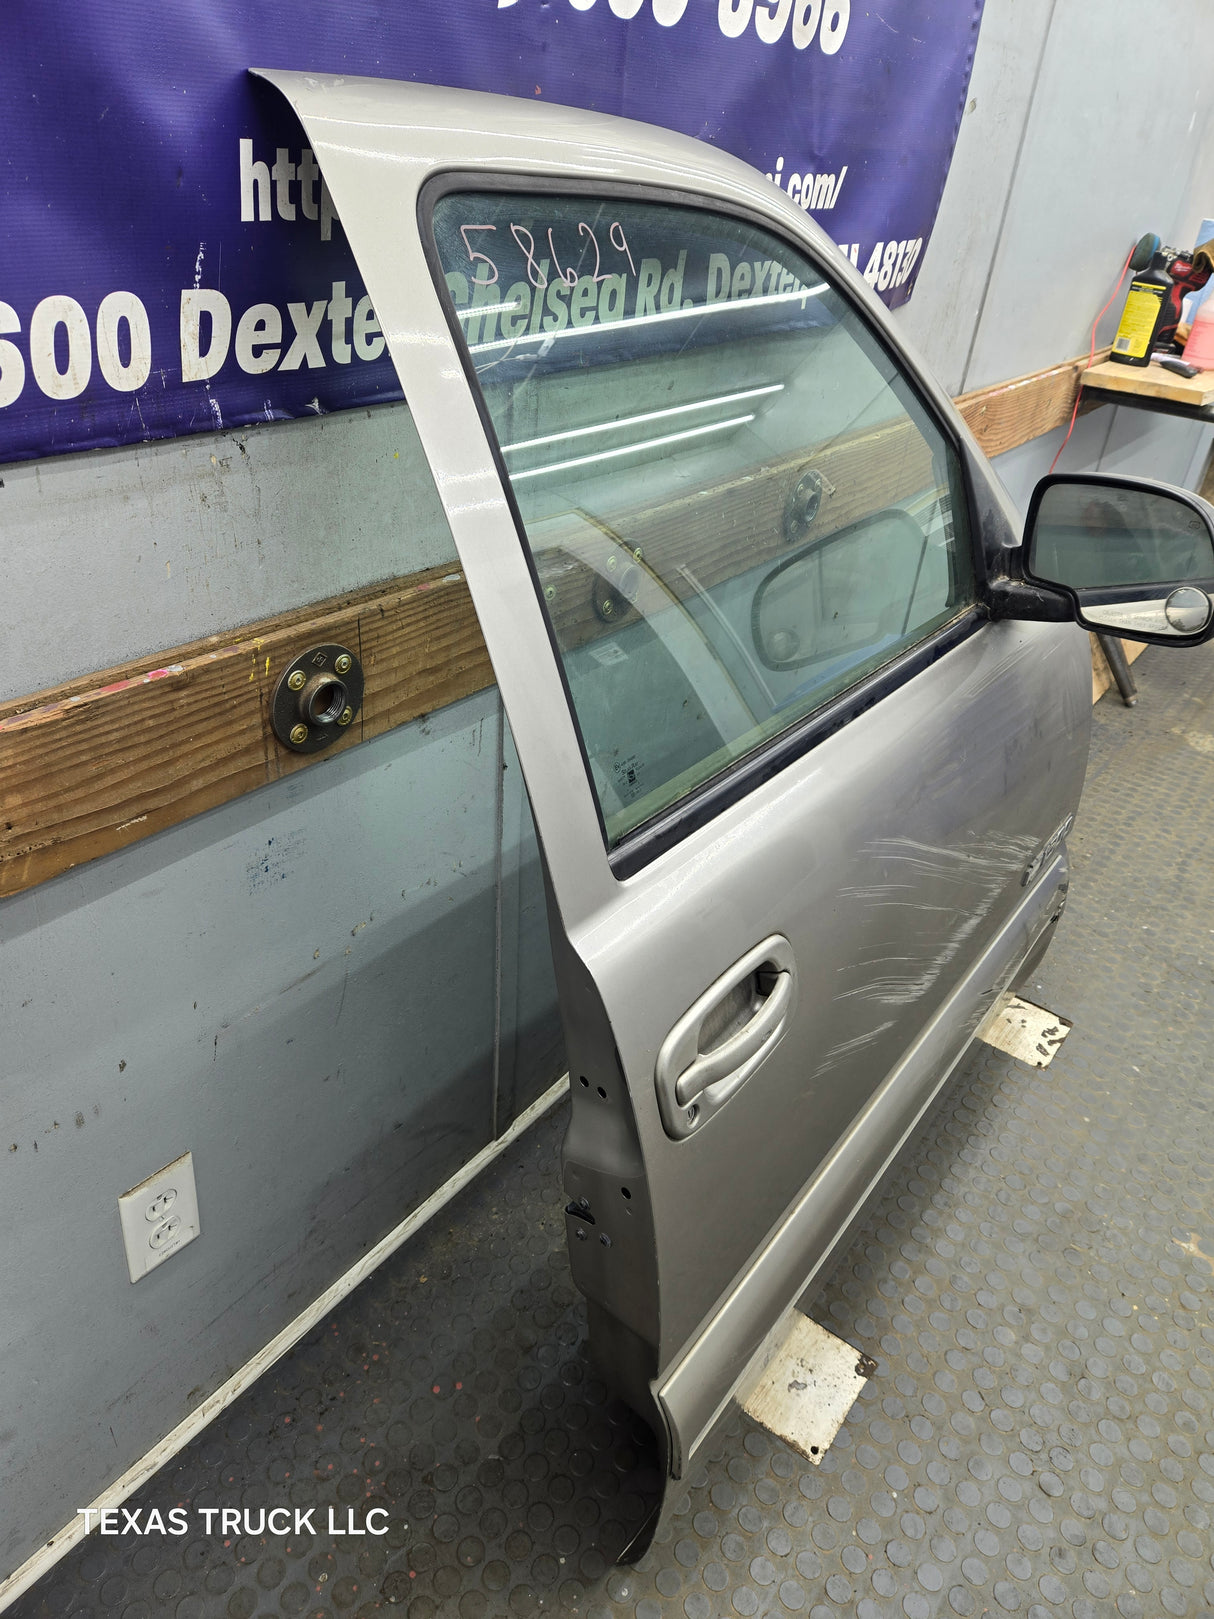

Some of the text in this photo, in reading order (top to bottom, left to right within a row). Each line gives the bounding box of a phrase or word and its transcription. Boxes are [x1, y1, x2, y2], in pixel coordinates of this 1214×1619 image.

[460, 222, 637, 289] 58629
[180, 281, 392, 384] Dexte
[634, 250, 694, 321] Rd.
[863, 237, 923, 292] 48130
